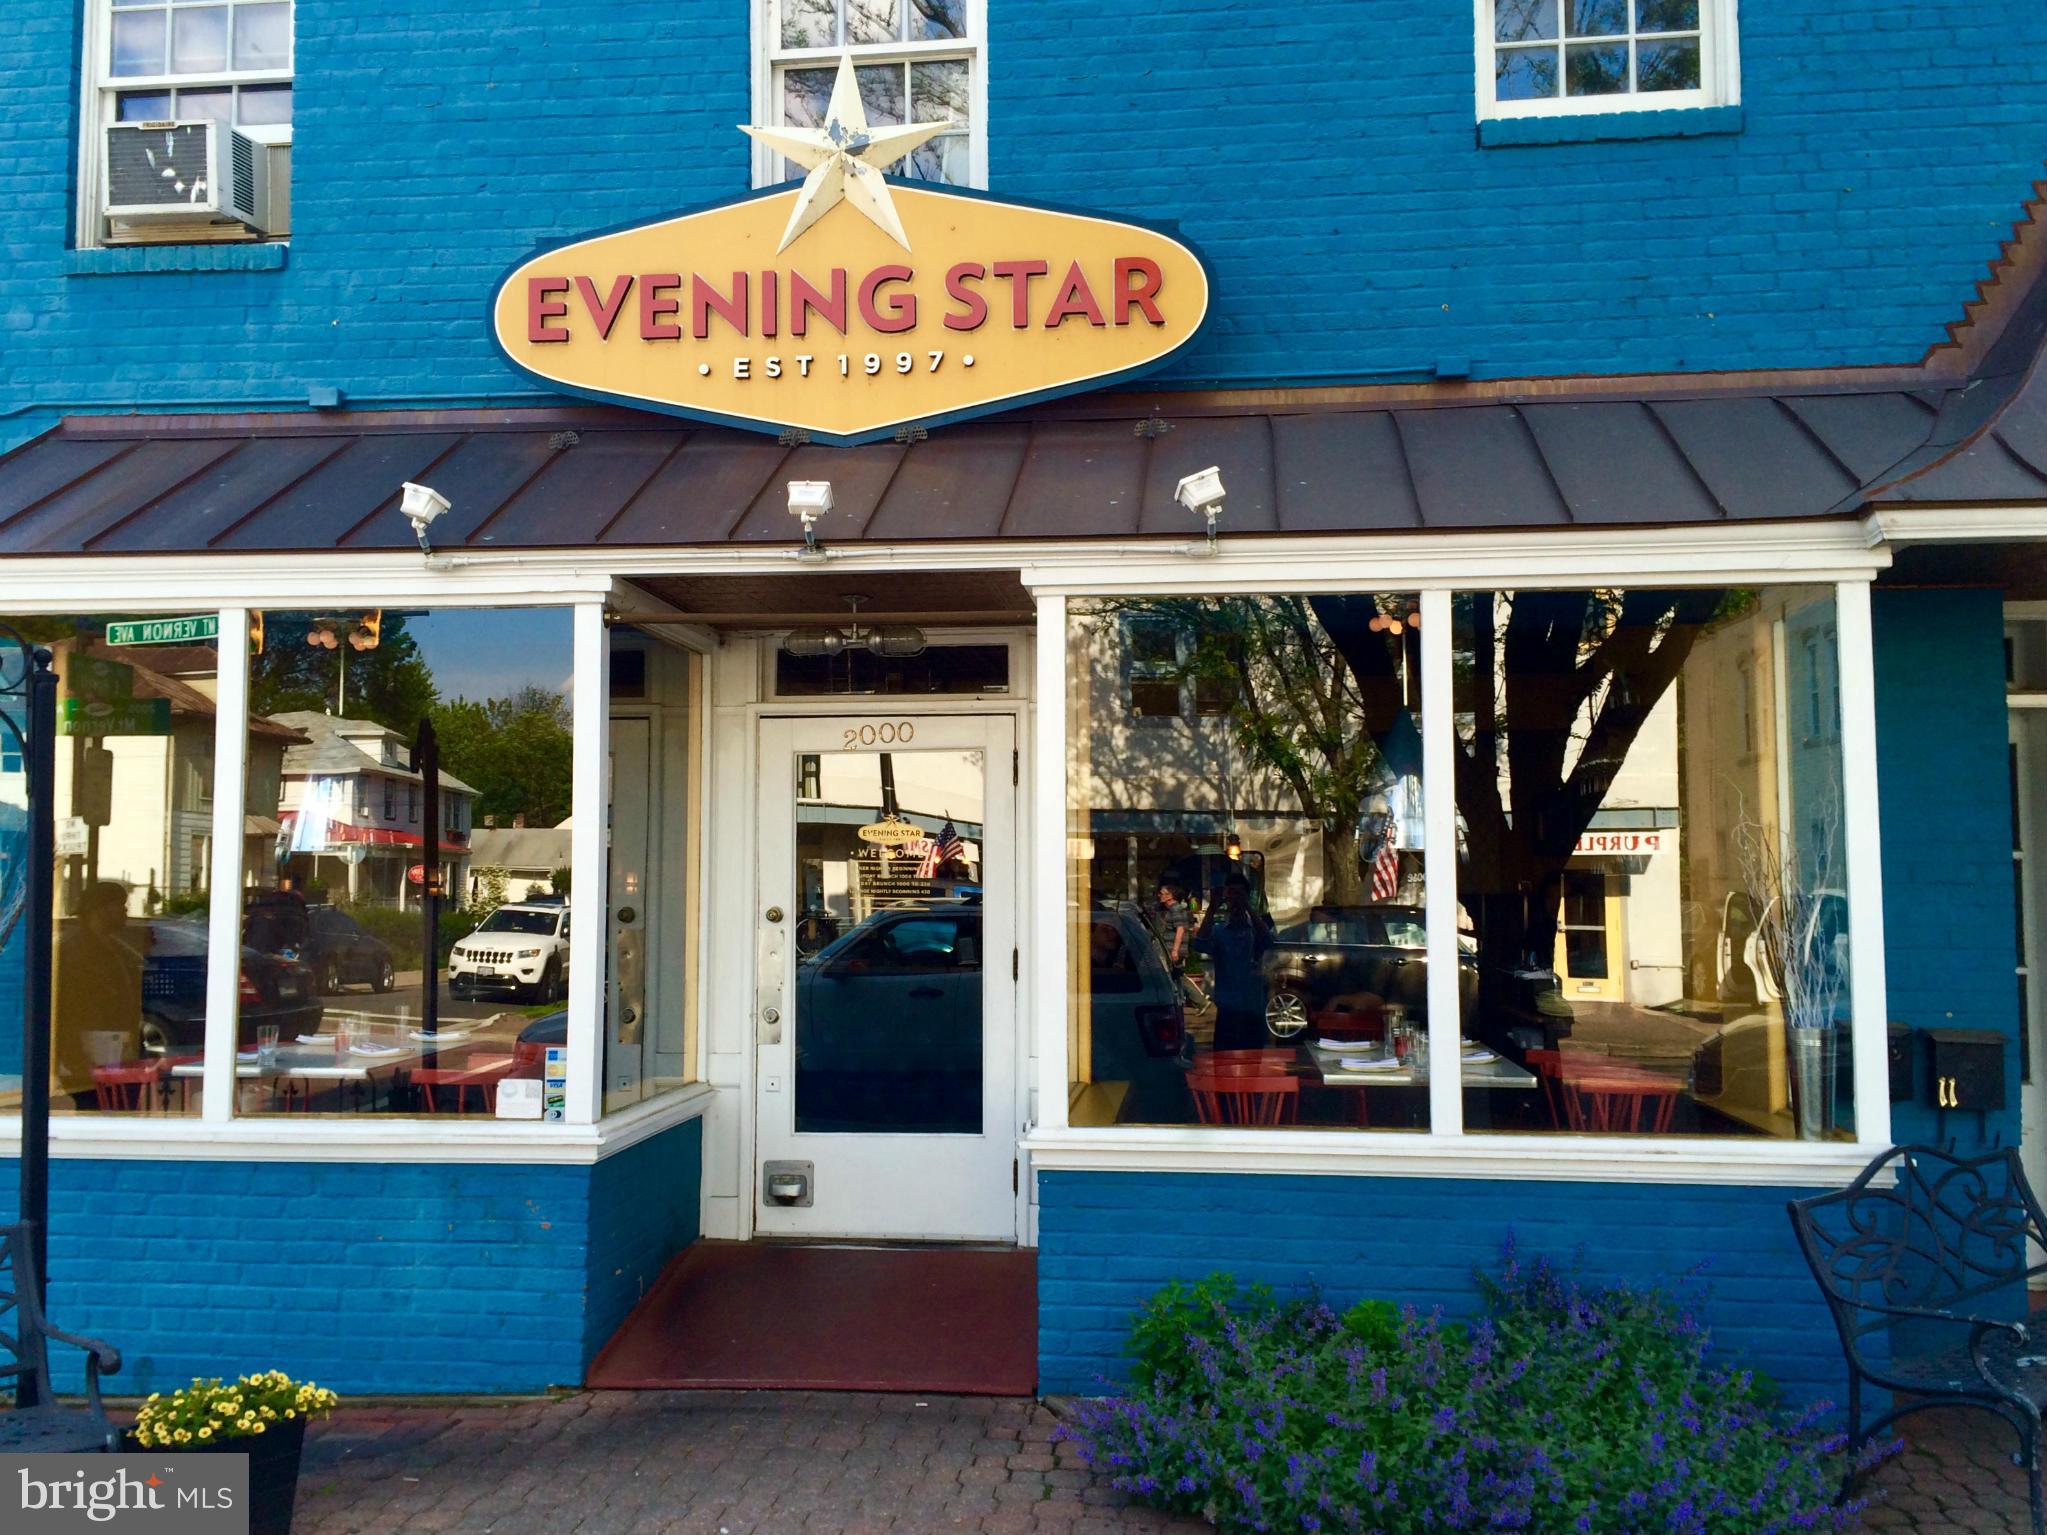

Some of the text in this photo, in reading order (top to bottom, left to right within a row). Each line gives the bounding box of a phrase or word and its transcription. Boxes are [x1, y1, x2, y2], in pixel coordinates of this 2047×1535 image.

[528, 257, 1165, 343] EVENING STAR
[733, 350, 945, 379] EST 1997
[843, 721, 915, 752] 2000
[862, 829, 921, 837] EVENING STAR
[858, 848, 925, 858] WELOME
